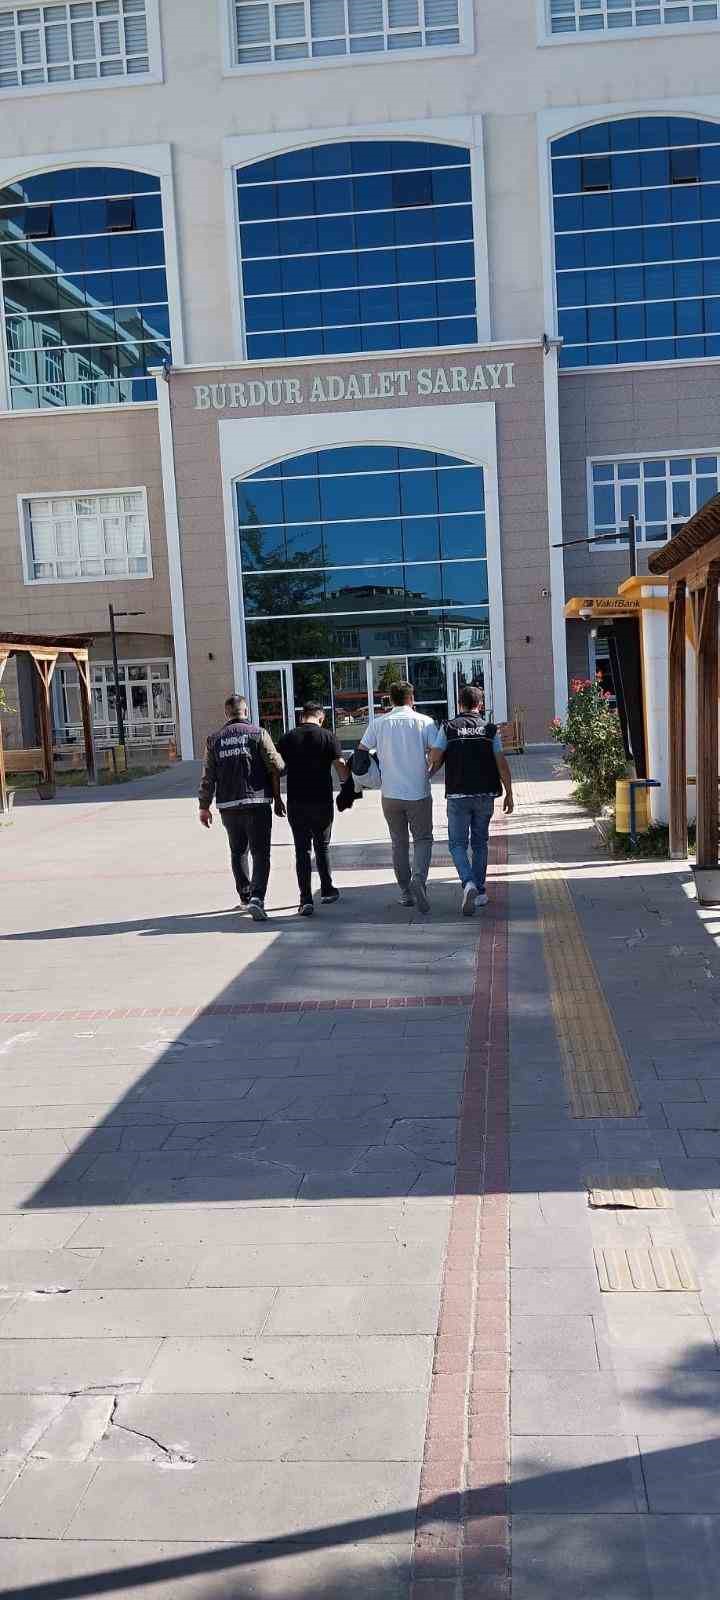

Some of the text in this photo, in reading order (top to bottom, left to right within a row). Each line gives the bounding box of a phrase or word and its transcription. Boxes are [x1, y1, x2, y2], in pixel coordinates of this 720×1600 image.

[193, 362, 515, 409] BURDUR ADALET SARAYI
